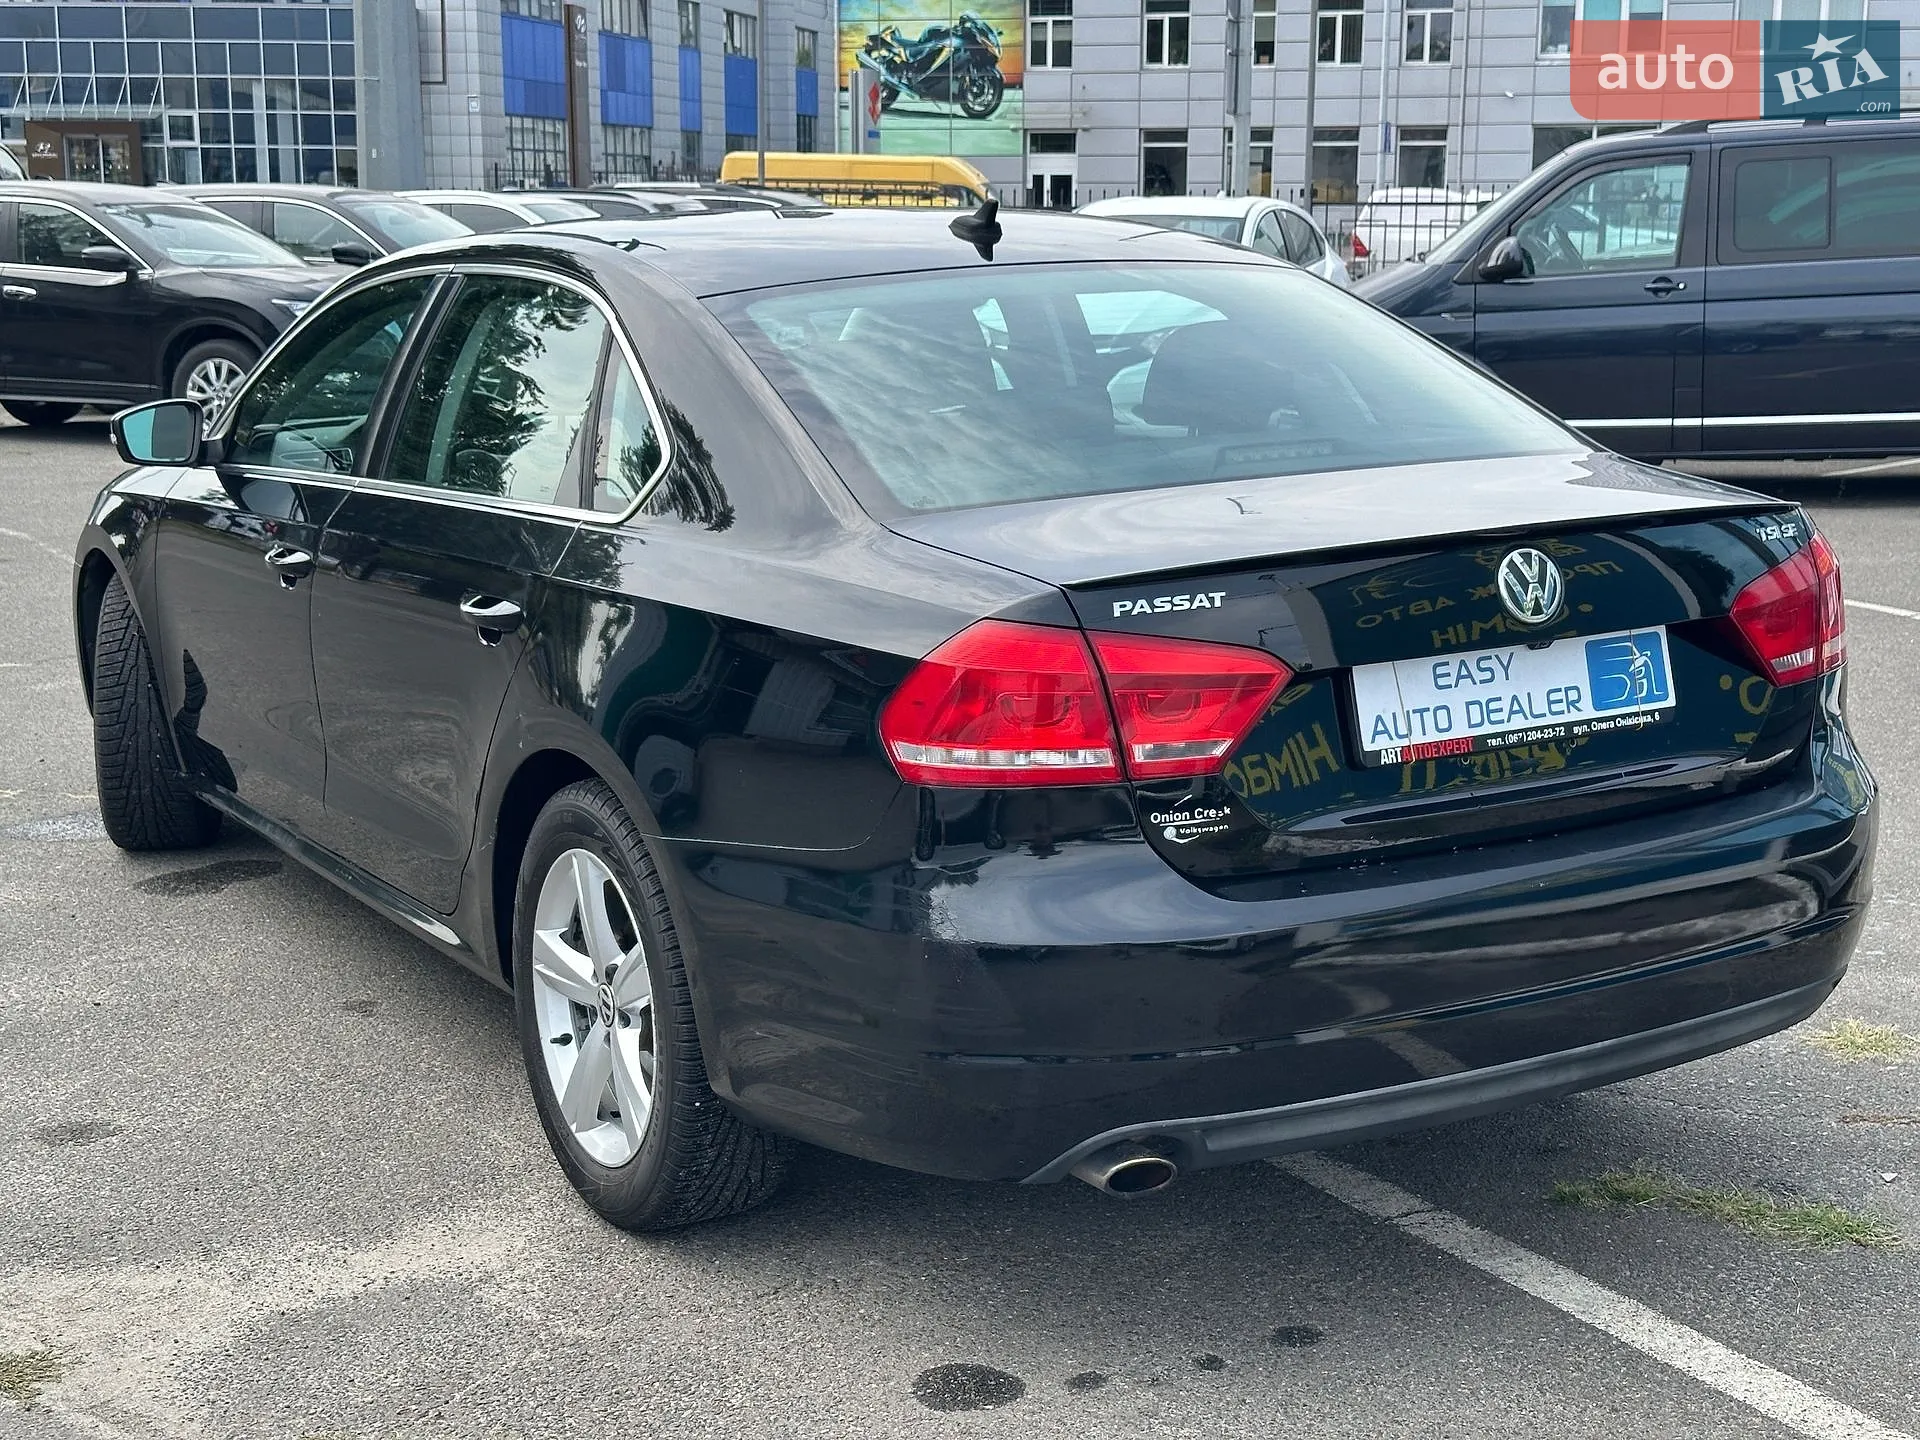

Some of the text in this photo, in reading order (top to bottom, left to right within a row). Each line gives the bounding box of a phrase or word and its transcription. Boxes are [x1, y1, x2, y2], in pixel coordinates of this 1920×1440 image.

[1112, 591, 1227, 618] PASSAT
[1431, 651, 1515, 690] EASY
[1370, 684, 1584, 744] AUTO DEALER
[1486, 737, 1505, 747] тел.
[1591, 720, 1615, 731] Олега
[1150, 810, 1190, 824] Onion
